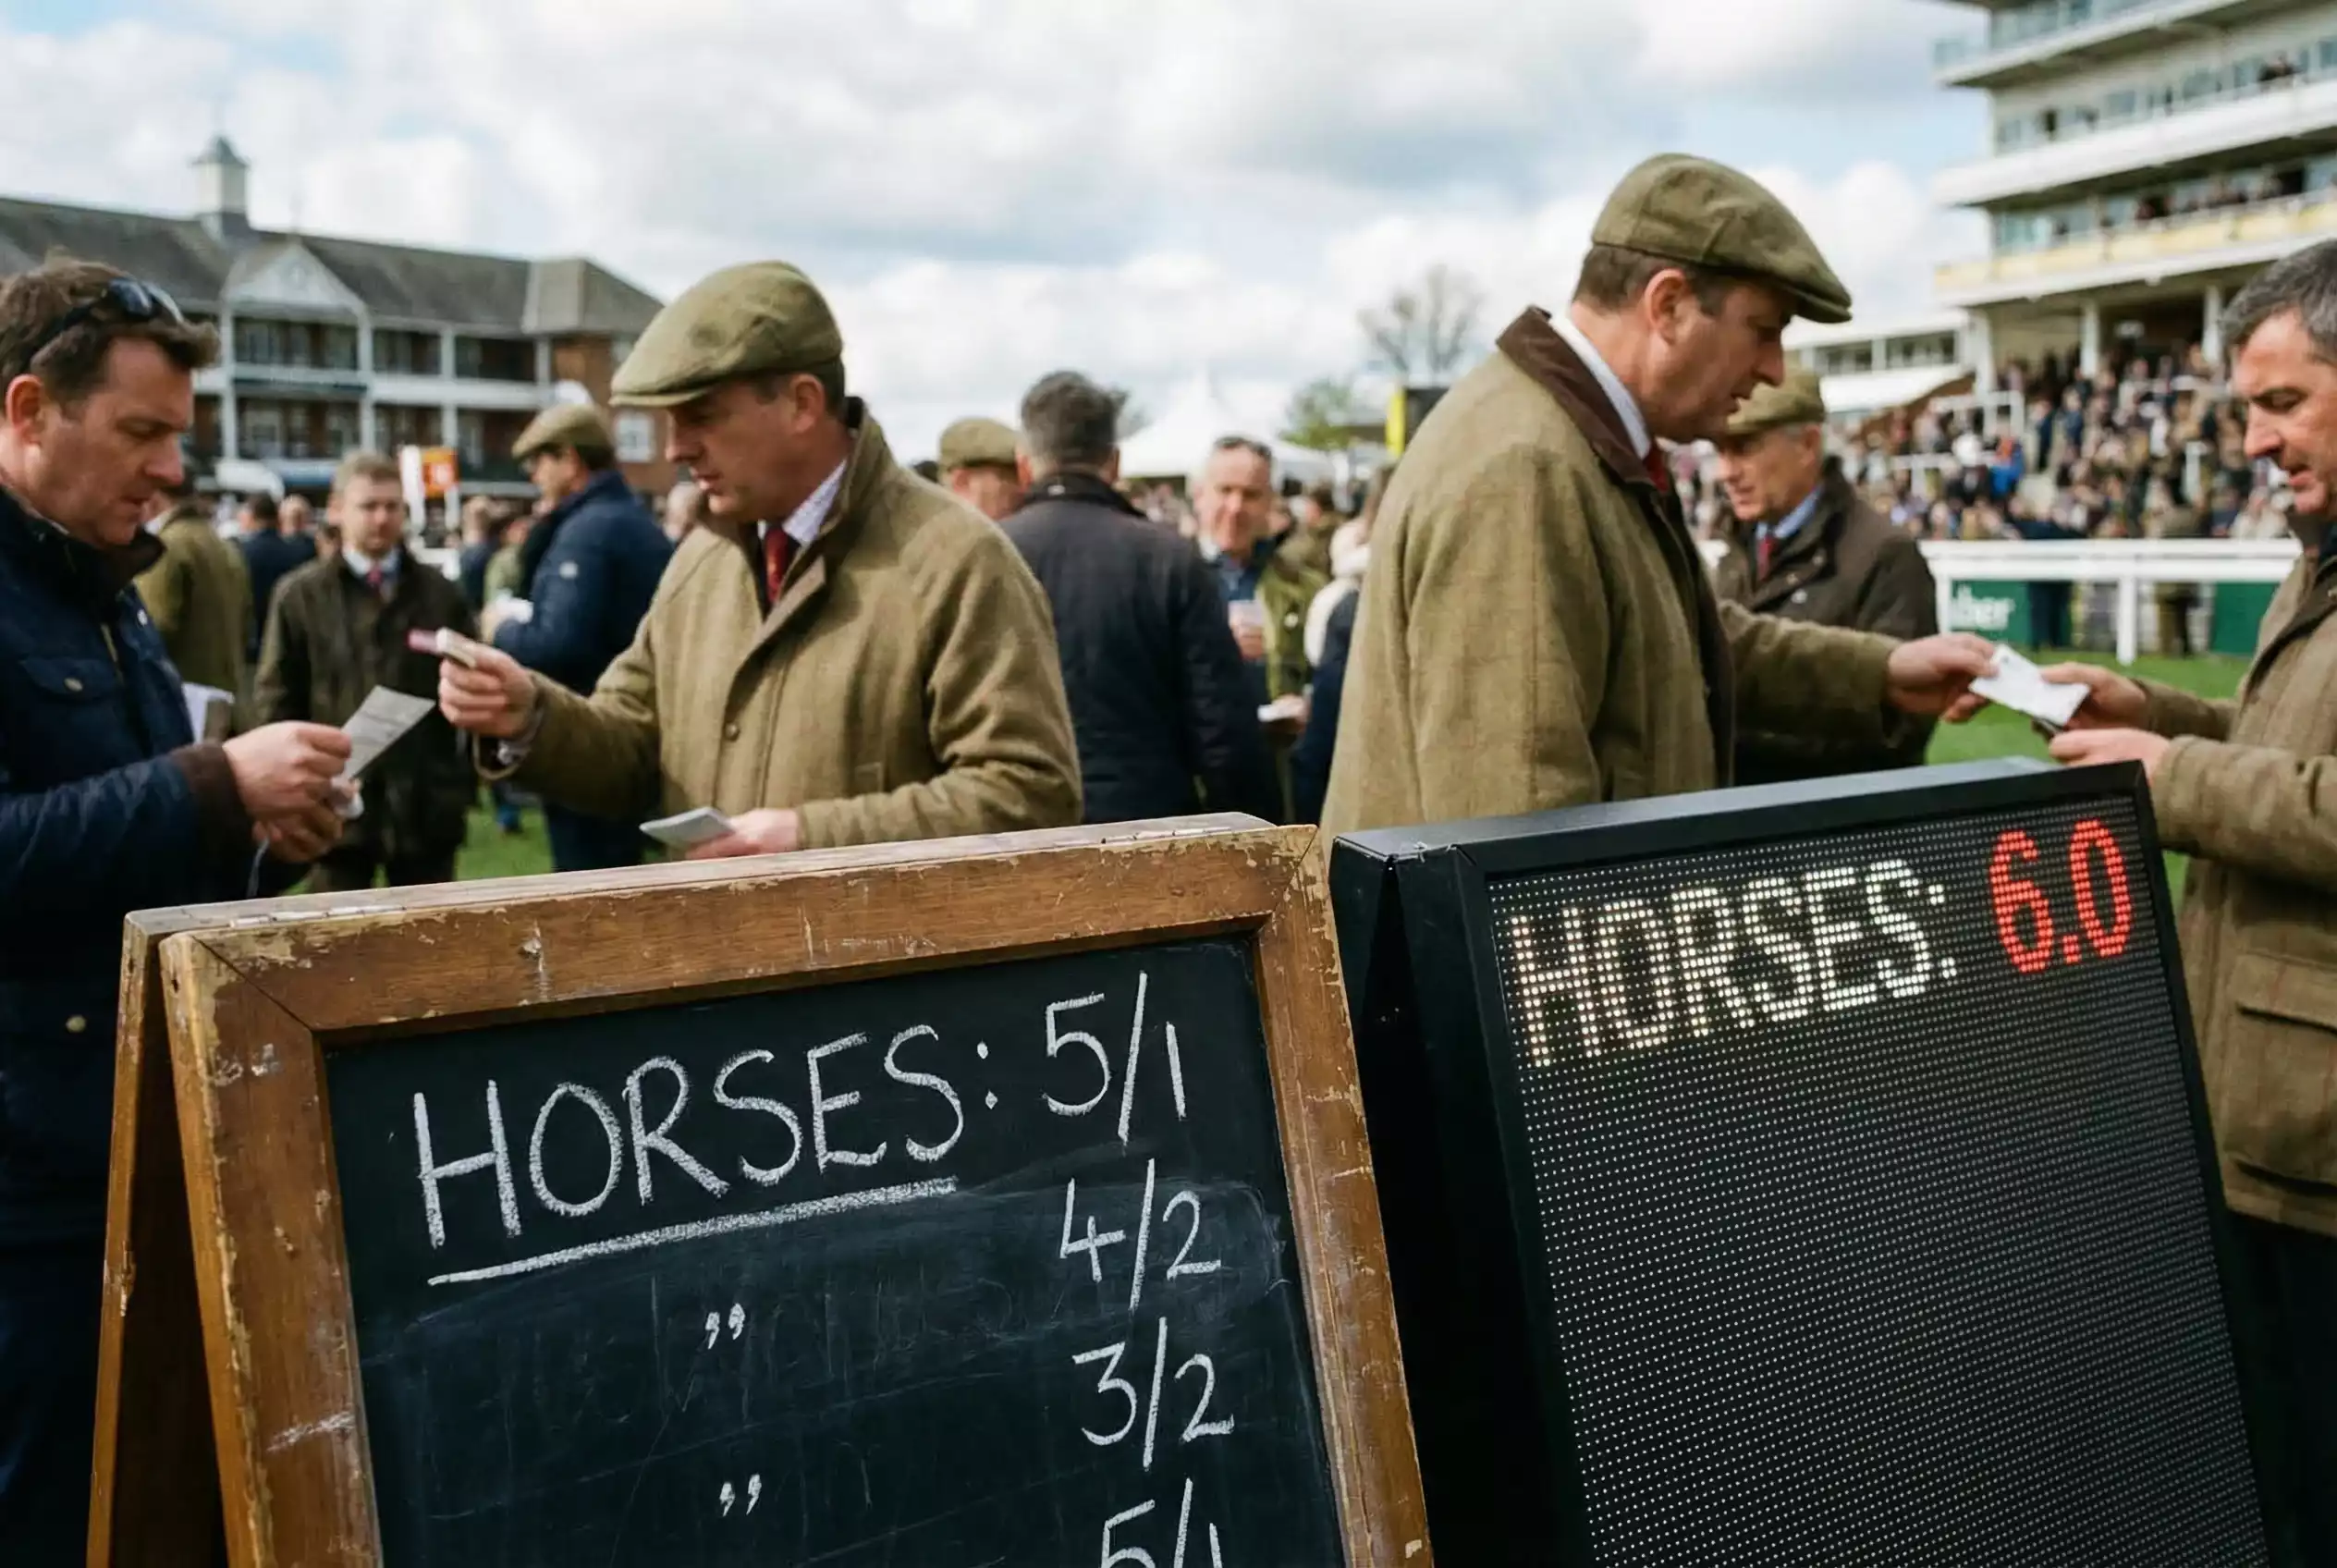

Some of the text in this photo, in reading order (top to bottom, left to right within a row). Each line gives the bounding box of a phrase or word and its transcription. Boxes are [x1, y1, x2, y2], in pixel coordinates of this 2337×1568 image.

[1508, 818, 2134, 1069] HORSES: 6.0
[413, 972, 1187, 1249] HORSES: 5/1
[1059, 1158, 1222, 1309] 4/2
[1071, 1317, 1235, 1469] 3/2
